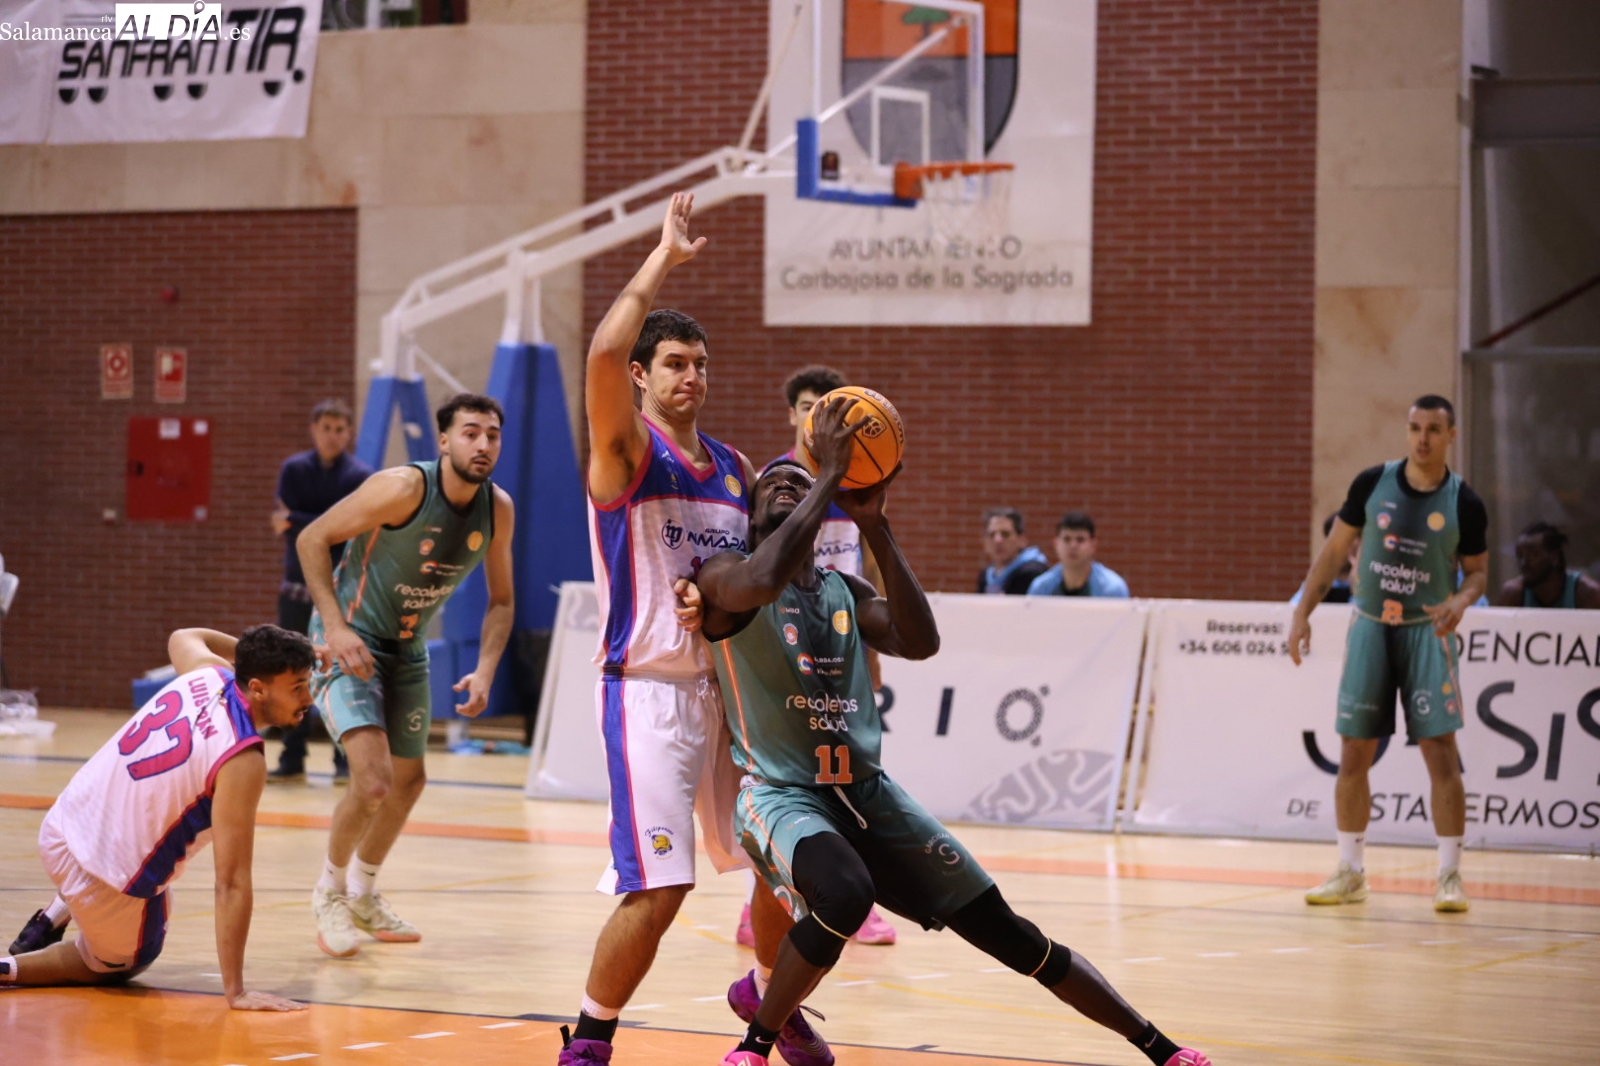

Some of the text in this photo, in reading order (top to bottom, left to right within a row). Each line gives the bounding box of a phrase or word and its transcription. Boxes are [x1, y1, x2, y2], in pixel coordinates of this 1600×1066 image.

[780, 264, 1074, 294] Carbajosa de la Sagrada
[1369, 560, 1431, 584] recoletas
[1206, 620, 1283, 634] Reservas:
[785, 692, 859, 713] recoletas
[809, 713, 848, 732] salud
[118, 690, 193, 781] 37
[815, 745, 853, 784] 11
[1287, 797, 1320, 819] DE
